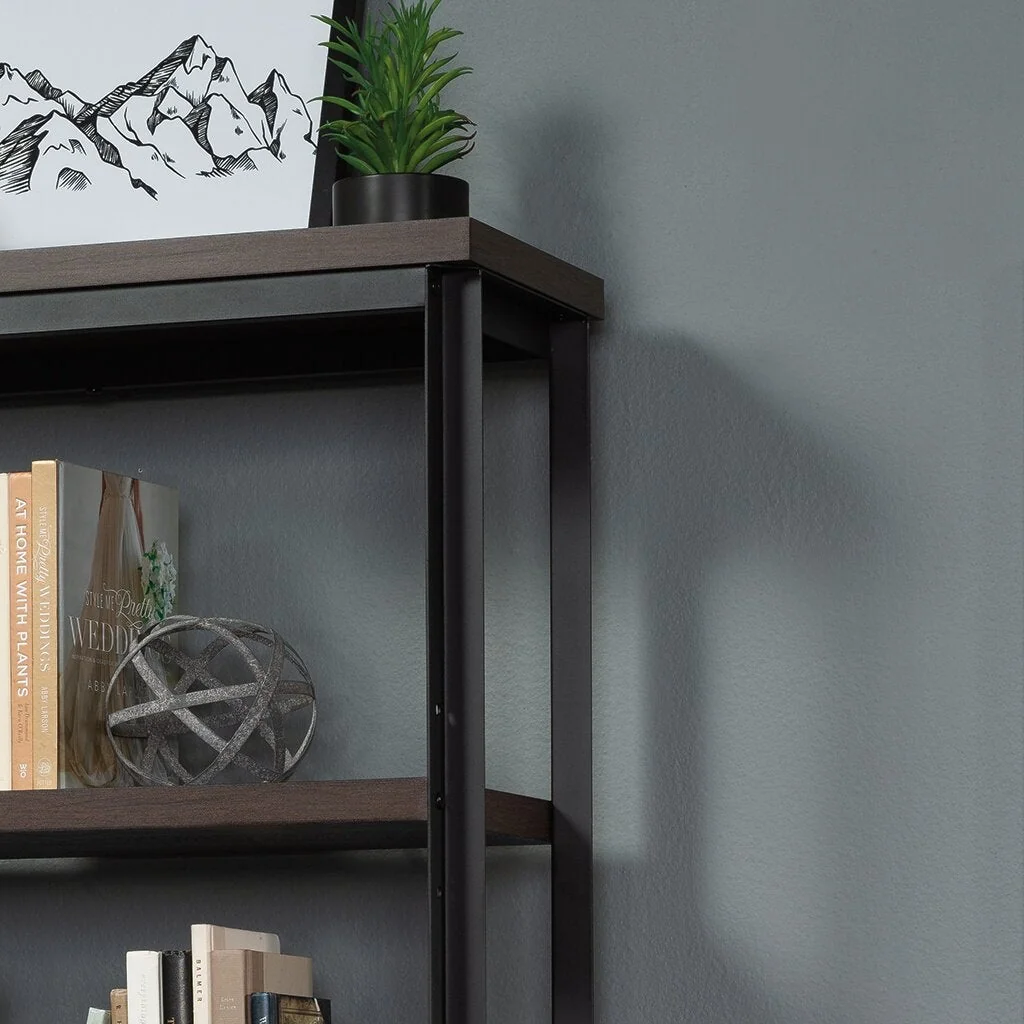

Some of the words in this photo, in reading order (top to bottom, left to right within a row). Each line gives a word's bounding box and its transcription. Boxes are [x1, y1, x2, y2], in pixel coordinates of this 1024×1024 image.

[15, 498, 27, 519] AT
[39, 505, 47, 526] STYLE
[15, 525, 27, 574] HOME
[39, 528, 47, 538] ME
[33, 534, 51, 584] Pretty
[16, 580, 28, 625] WITH
[85, 590, 104, 609] STYLE
[105, 594, 115, 612] ME
[39, 585, 50, 672] WEDDINGS
[17, 631, 29, 697] PLANTS
[40, 705, 49, 734] LARSON
[195, 959, 203, 1002] BALMER
